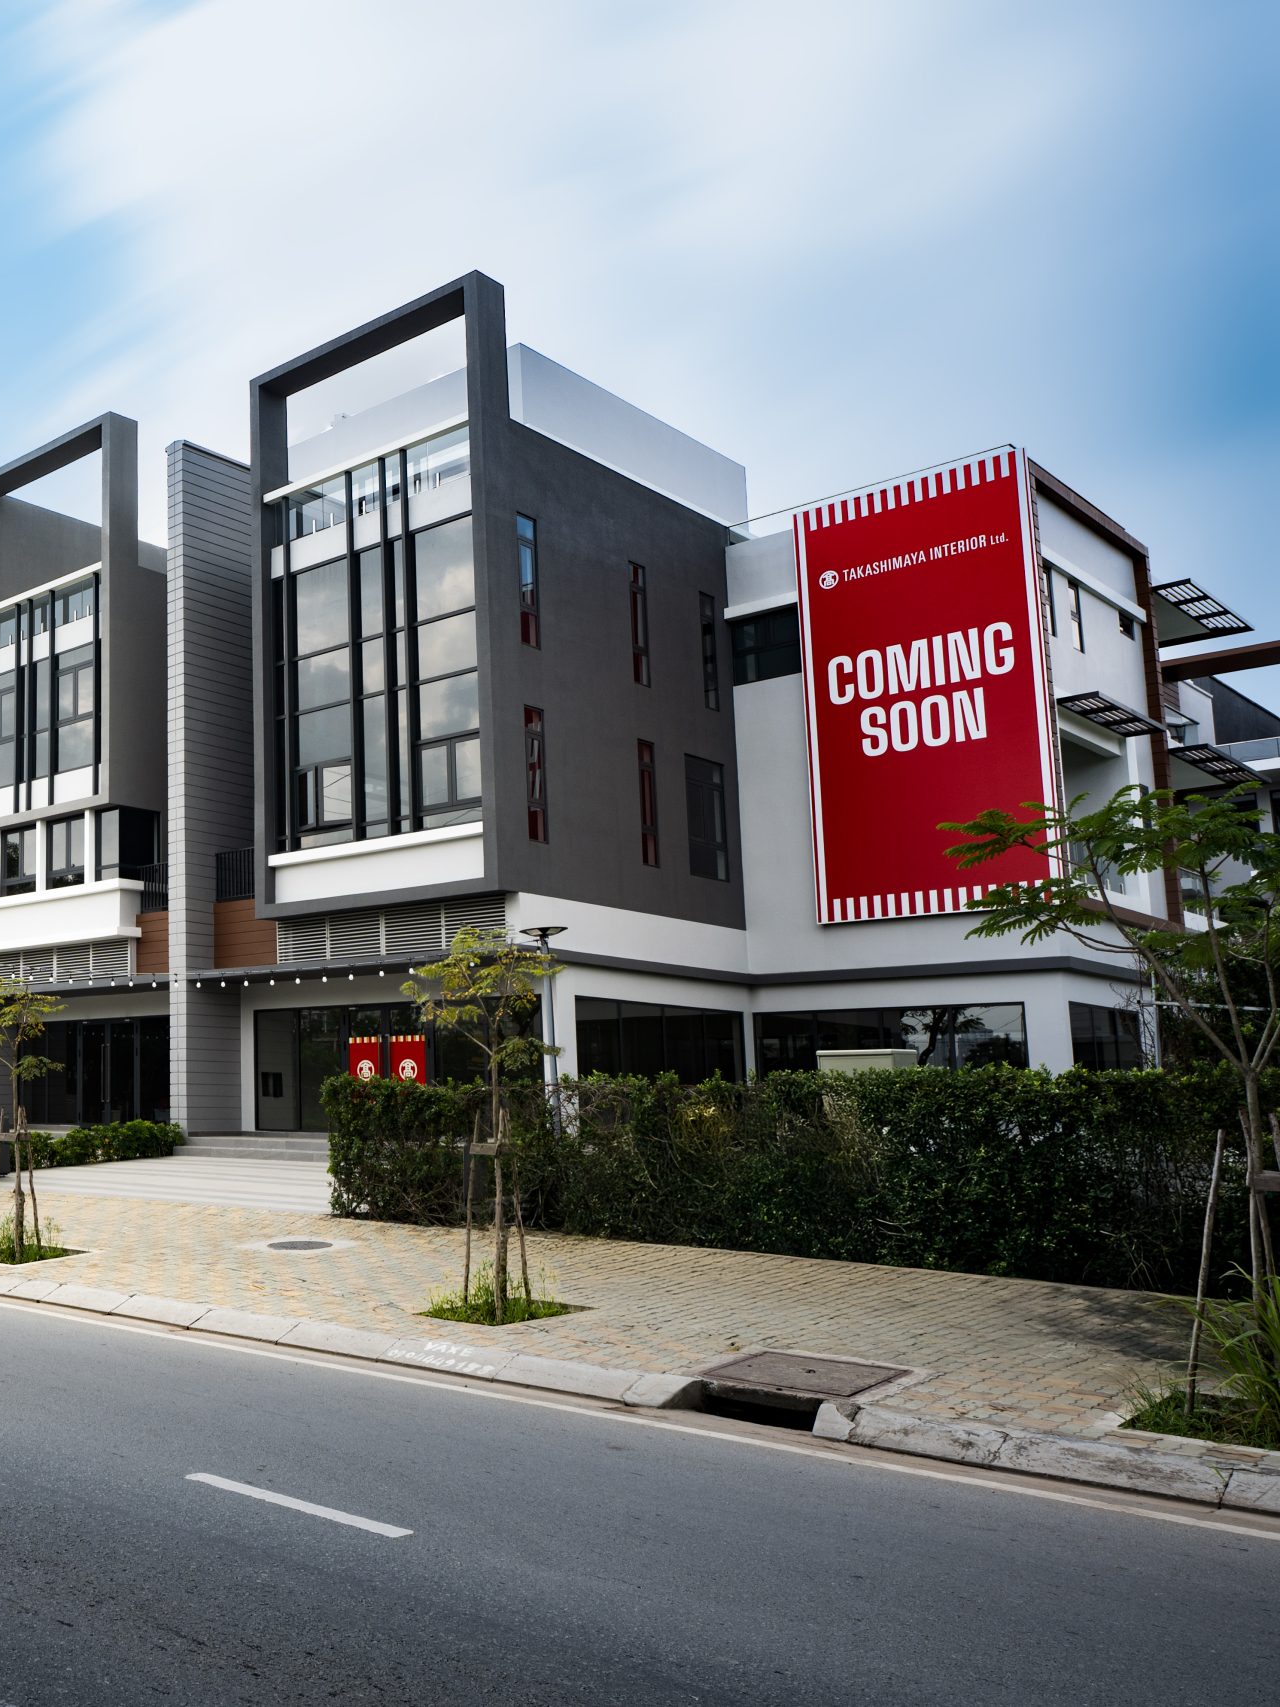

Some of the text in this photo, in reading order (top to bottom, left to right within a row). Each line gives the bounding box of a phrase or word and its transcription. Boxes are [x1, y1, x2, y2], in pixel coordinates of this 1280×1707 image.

[843, 532, 1009, 582] TAKASHIMAYA INTERIOR Ltd.
[827, 621, 1015, 705] COMING
[860, 687, 988, 757] SOON
